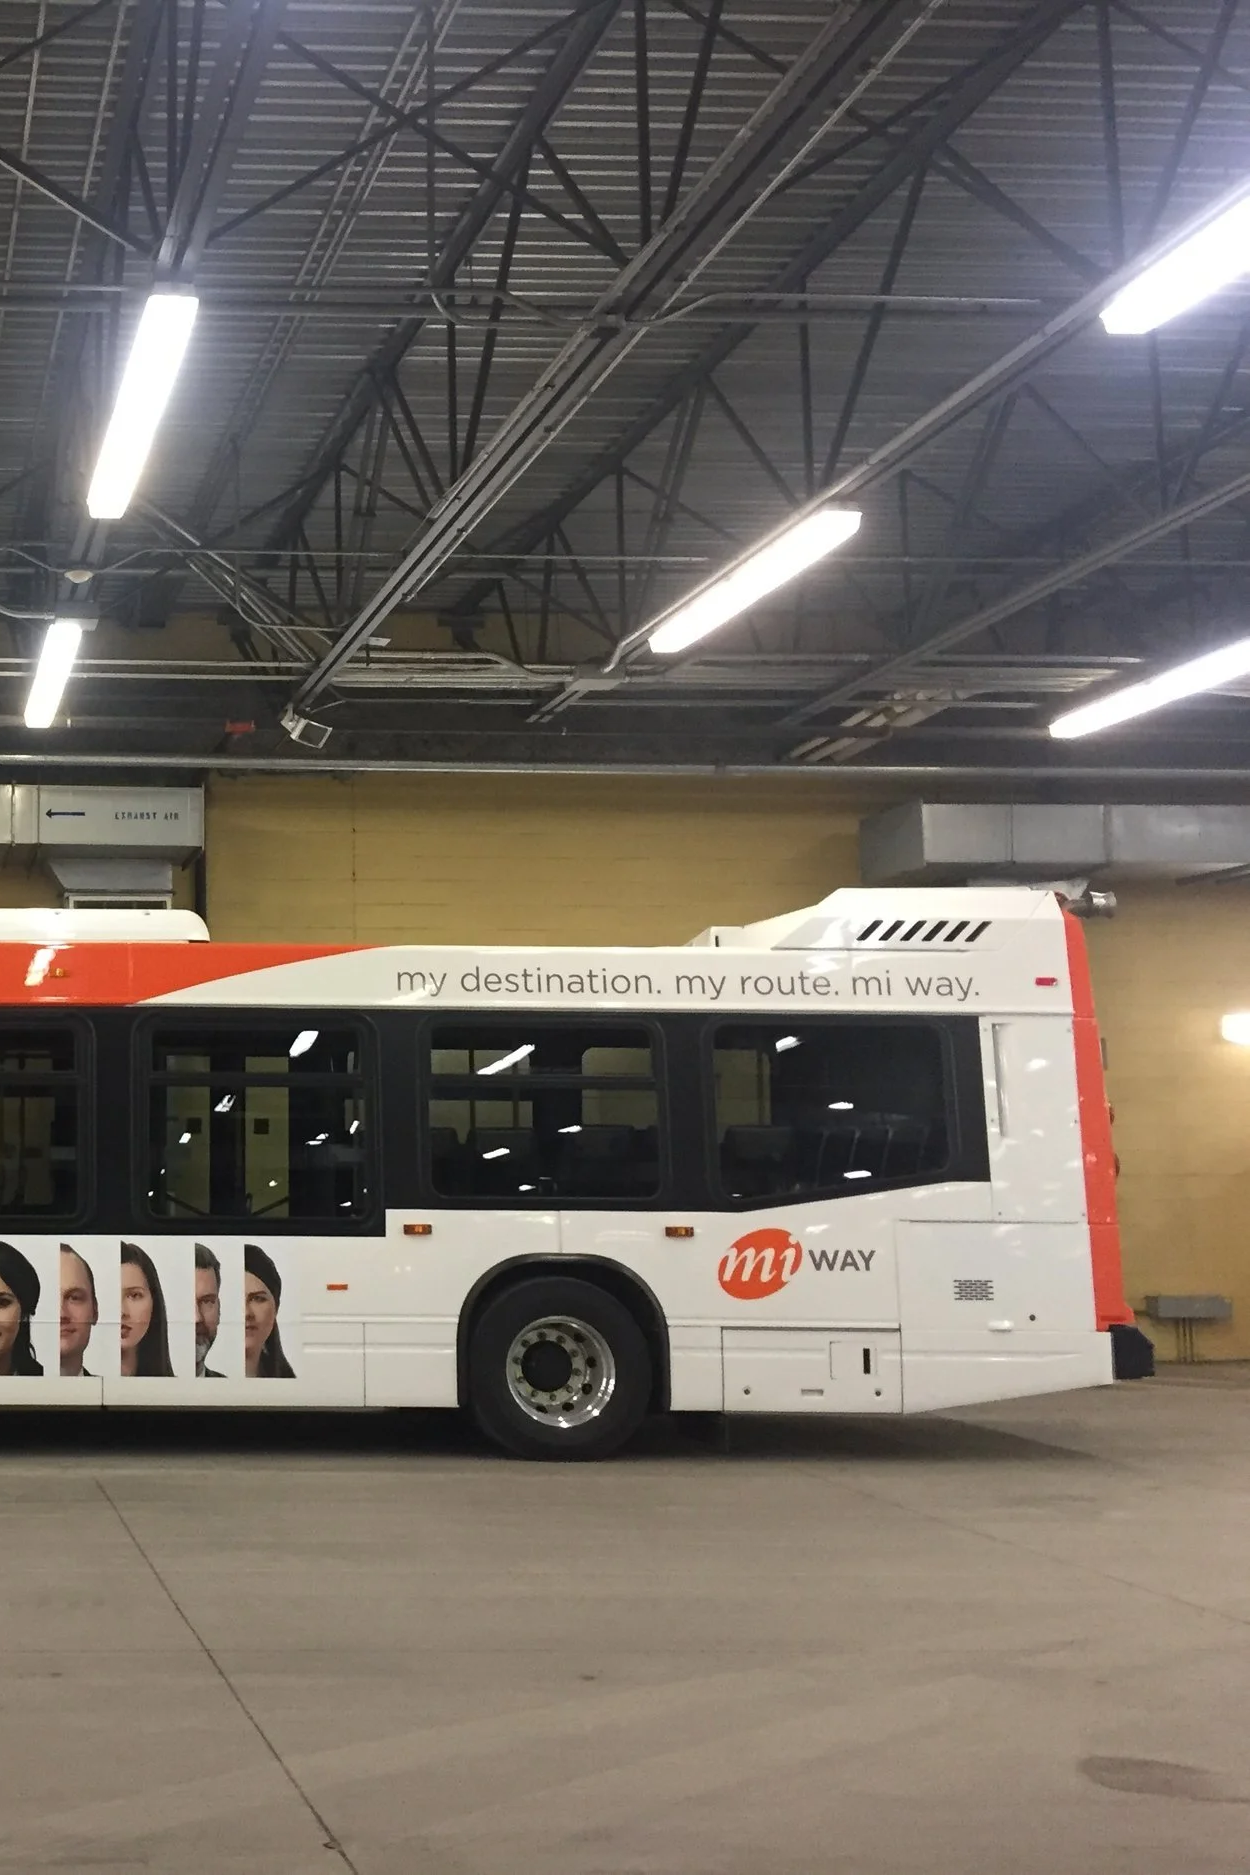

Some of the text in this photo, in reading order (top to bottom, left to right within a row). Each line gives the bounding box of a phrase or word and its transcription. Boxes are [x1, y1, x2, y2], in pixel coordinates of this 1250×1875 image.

[397, 966, 980, 1001] my destination. my route. mi way.
[721, 1234, 876, 1283] mi WAY
